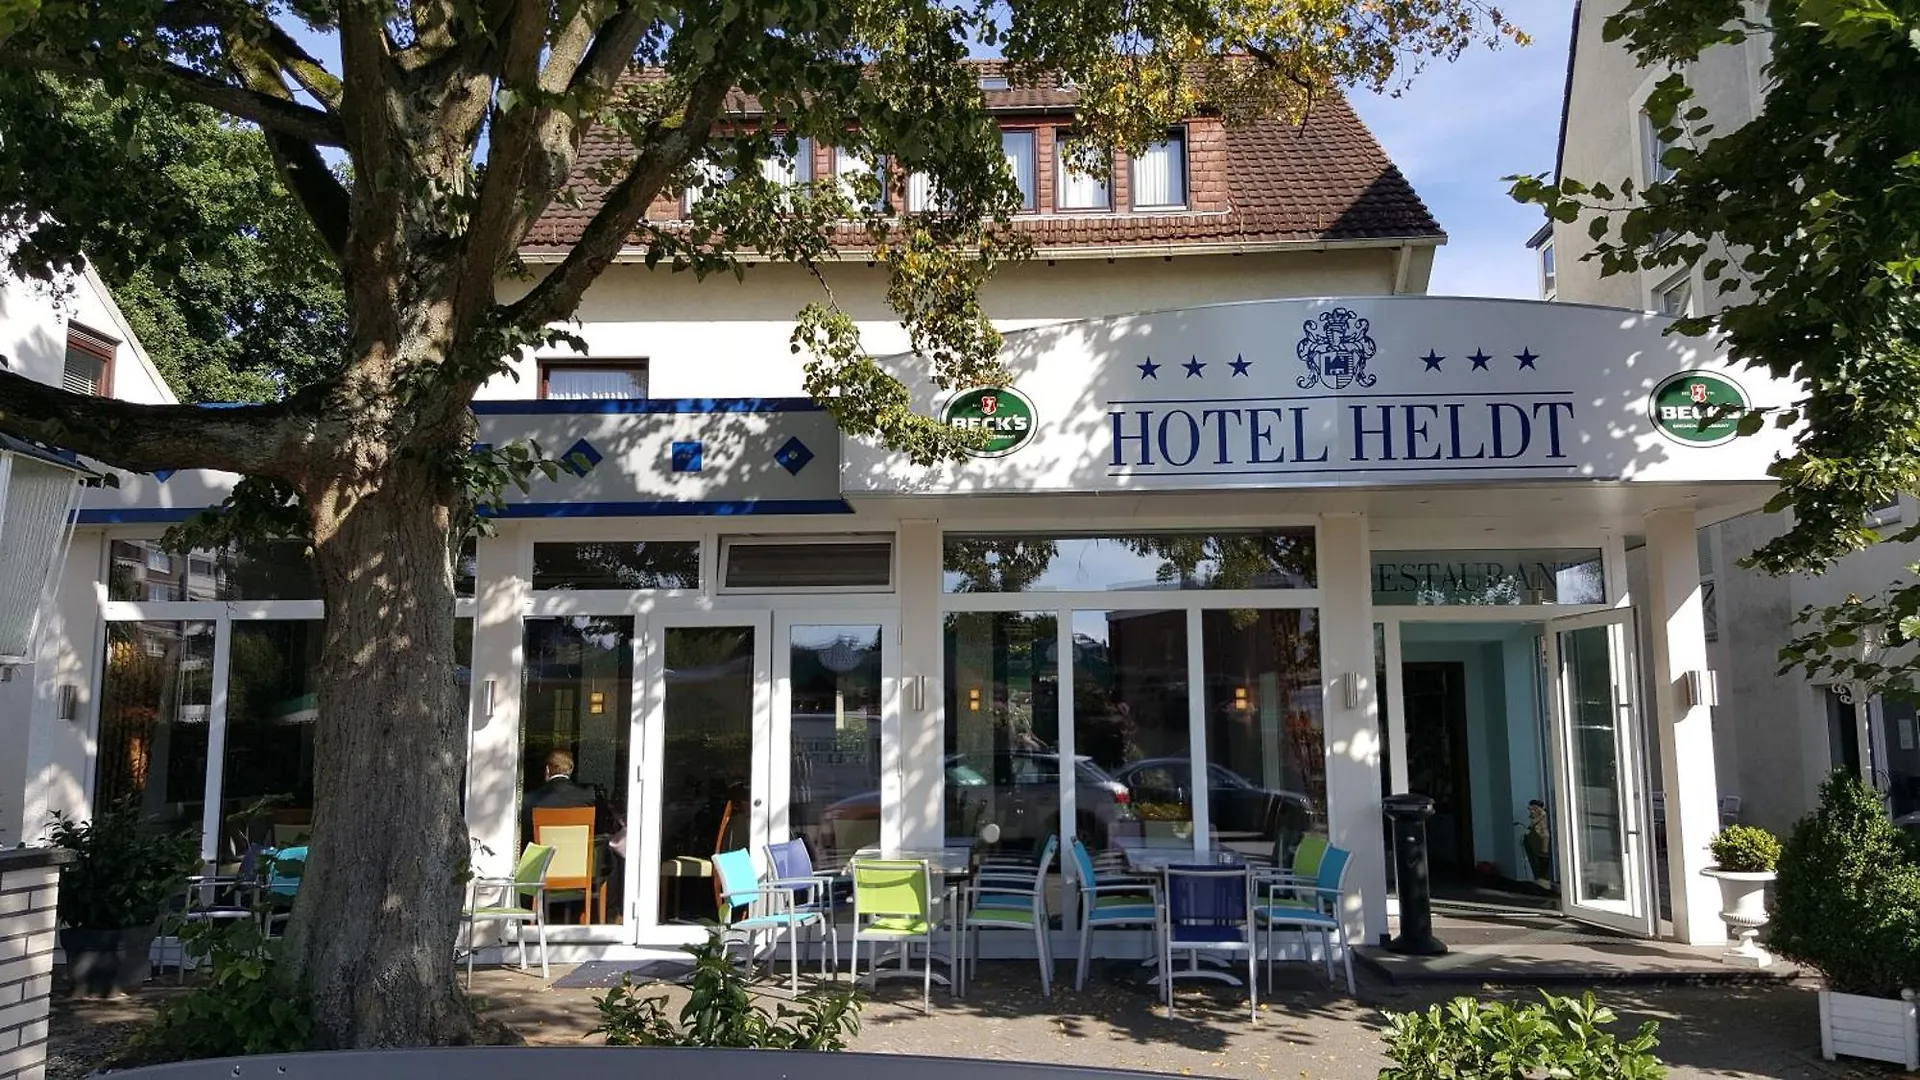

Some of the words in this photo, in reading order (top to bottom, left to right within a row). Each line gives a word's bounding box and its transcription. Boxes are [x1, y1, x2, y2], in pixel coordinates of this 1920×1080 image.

[952, 413, 1028, 431] BECK'S
[1108, 406, 1329, 467] HOTEL
[1348, 401, 1575, 463] HELDT
[1372, 561, 1582, 592] ESTAURAN
